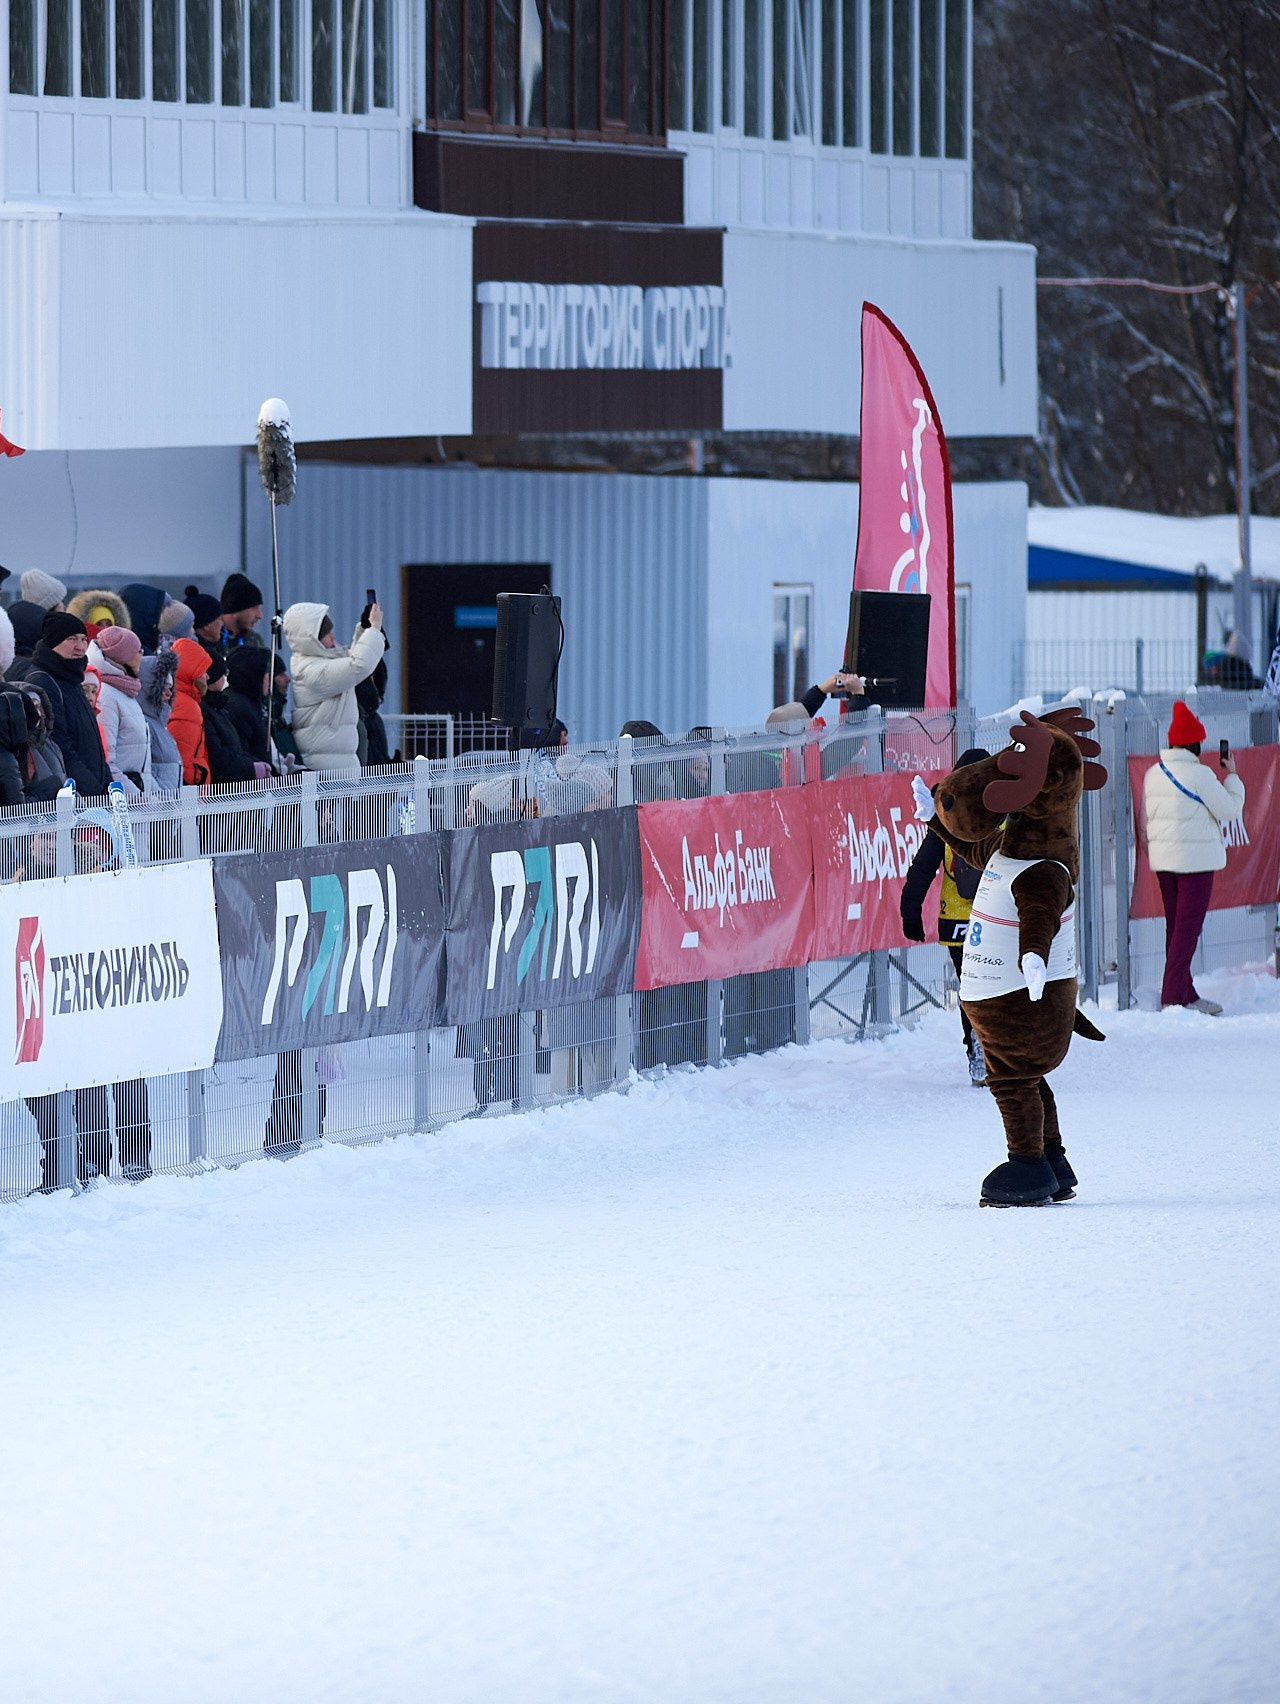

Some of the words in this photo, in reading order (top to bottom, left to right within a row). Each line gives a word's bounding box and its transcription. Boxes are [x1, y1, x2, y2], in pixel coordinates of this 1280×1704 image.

[477, 281, 644, 369] ТЕРРИТОРИЯ
[645, 285, 732, 370] СПОРТА
[682, 832, 738, 928] Альфа
[735, 830, 776, 904] Банк
[848, 808, 897, 899] Альфа
[890, 807, 928, 878] Ба
[261, 863, 398, 1025] PARI
[487, 837, 600, 990] PARI
